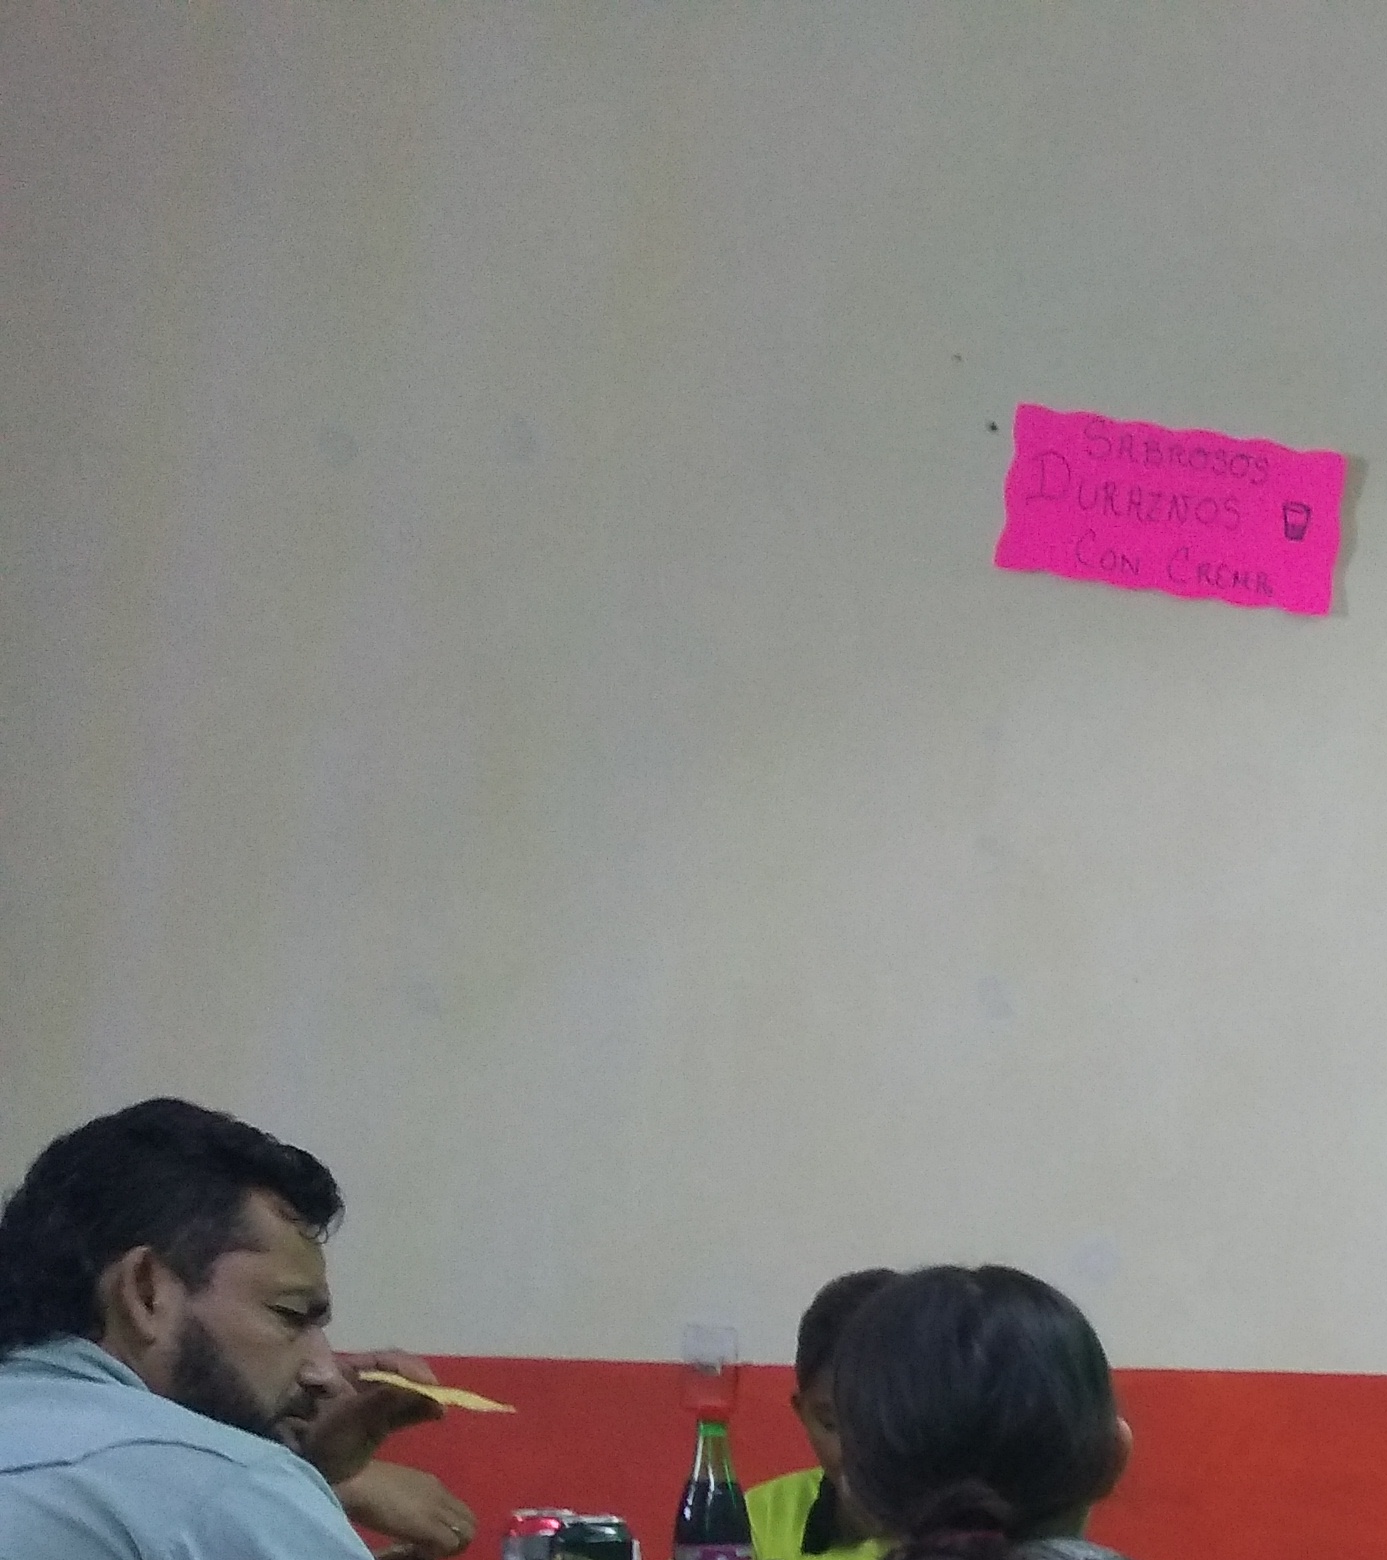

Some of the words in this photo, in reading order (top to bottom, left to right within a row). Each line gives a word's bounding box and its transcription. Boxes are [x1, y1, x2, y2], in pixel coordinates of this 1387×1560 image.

[1083, 420, 1270, 486] SABROSOS
[1026, 450, 1242, 531] DURAZNOS
[1075, 528, 1141, 577] CON
[1166, 546, 1274, 598] CREMA
